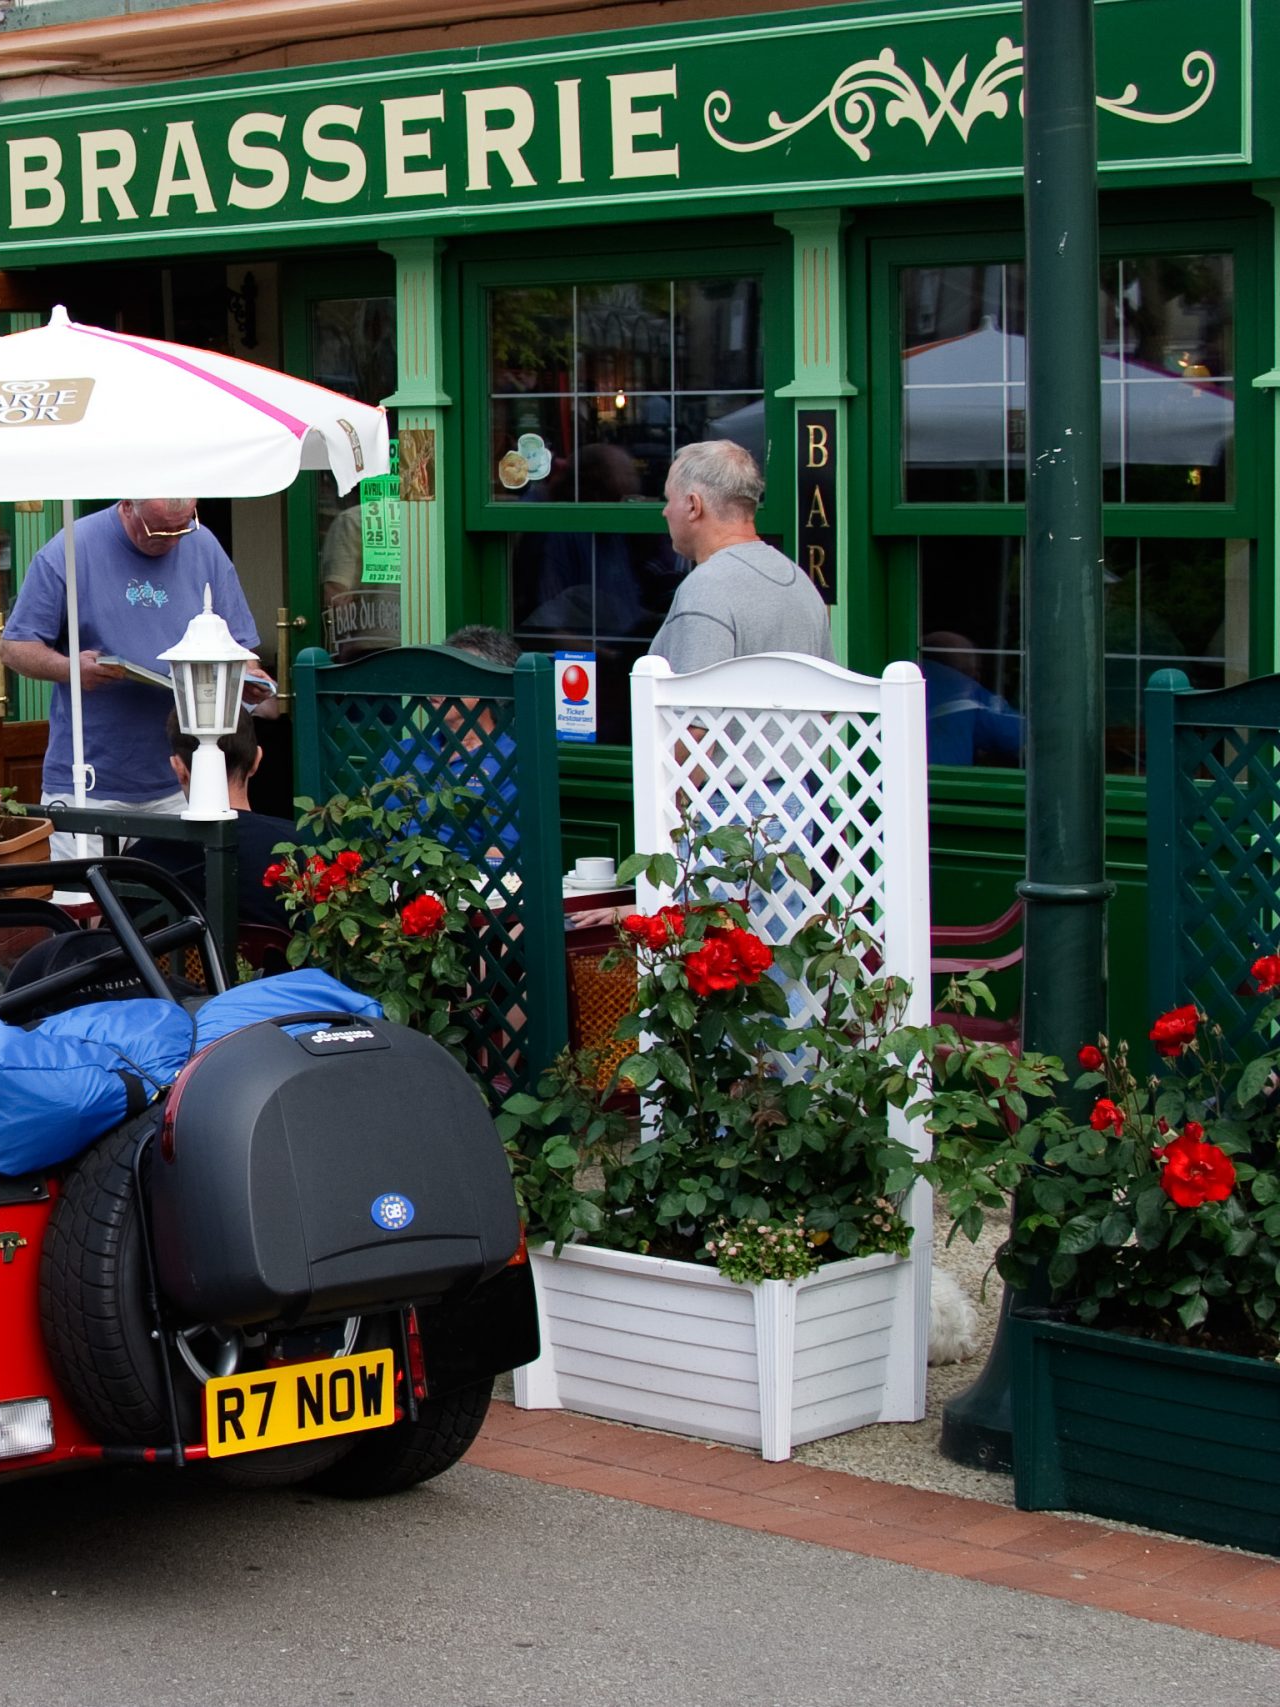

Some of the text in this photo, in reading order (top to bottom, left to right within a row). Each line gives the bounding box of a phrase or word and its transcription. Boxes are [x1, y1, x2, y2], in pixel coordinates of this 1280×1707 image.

[7, 63, 680, 229] BRASSERIE
[364, 482, 383, 496] AVRIL
[368, 501, 379, 515] 3
[806, 424, 830, 588] BAR
[366, 530, 384, 542] 25
[557, 714, 593, 723] Restaurant
[566, 707, 585, 716] Ticket
[385, 1203, 403, 1219] GB
[216, 1362, 385, 1444] R7 NOW
